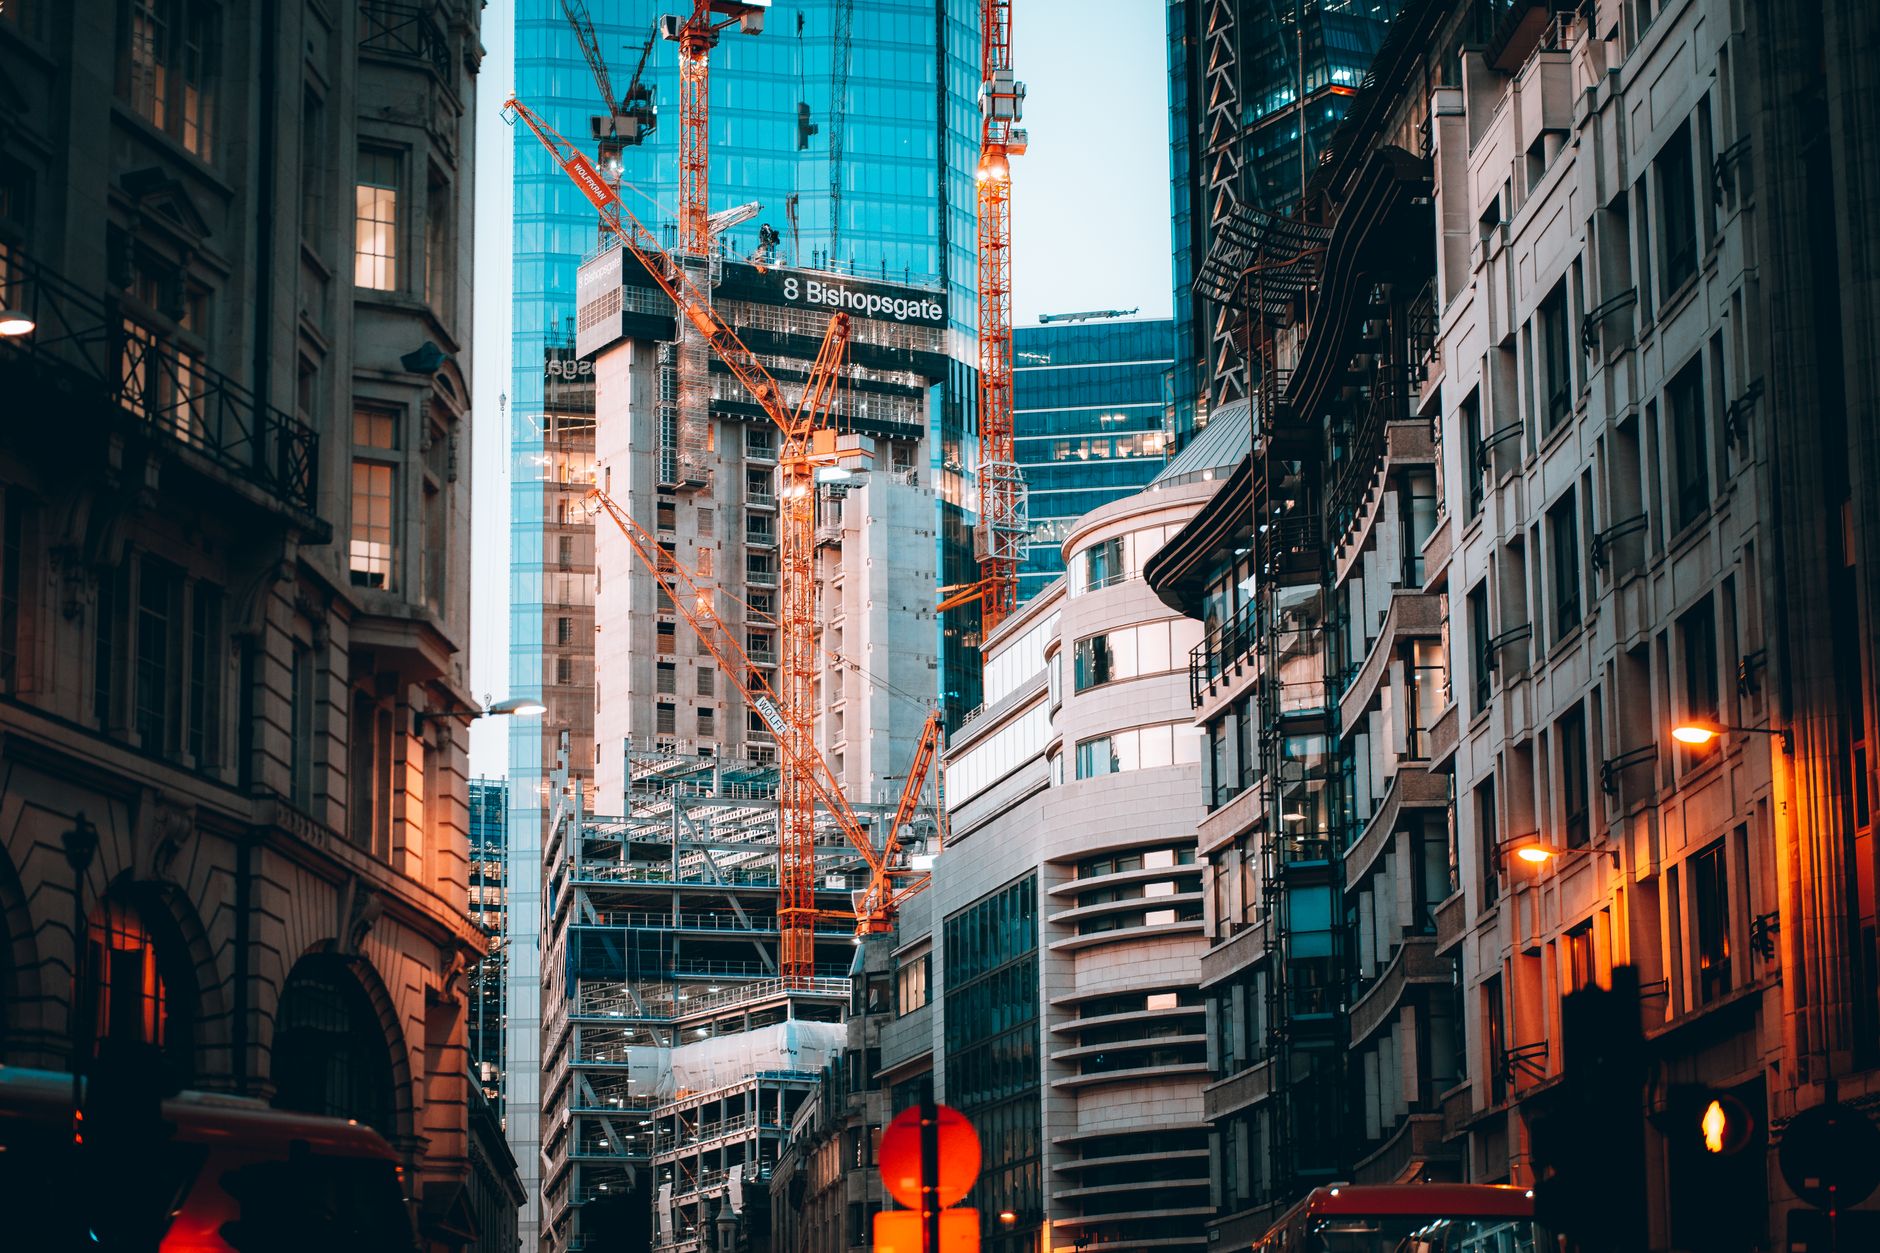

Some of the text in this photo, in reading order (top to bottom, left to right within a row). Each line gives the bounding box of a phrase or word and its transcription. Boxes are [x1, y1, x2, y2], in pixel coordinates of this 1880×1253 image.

[574, 163, 607, 200] WOLFFKRAN
[783, 277, 943, 321] 8 Bishopsgate
[758, 699, 786, 731] WOLFF
